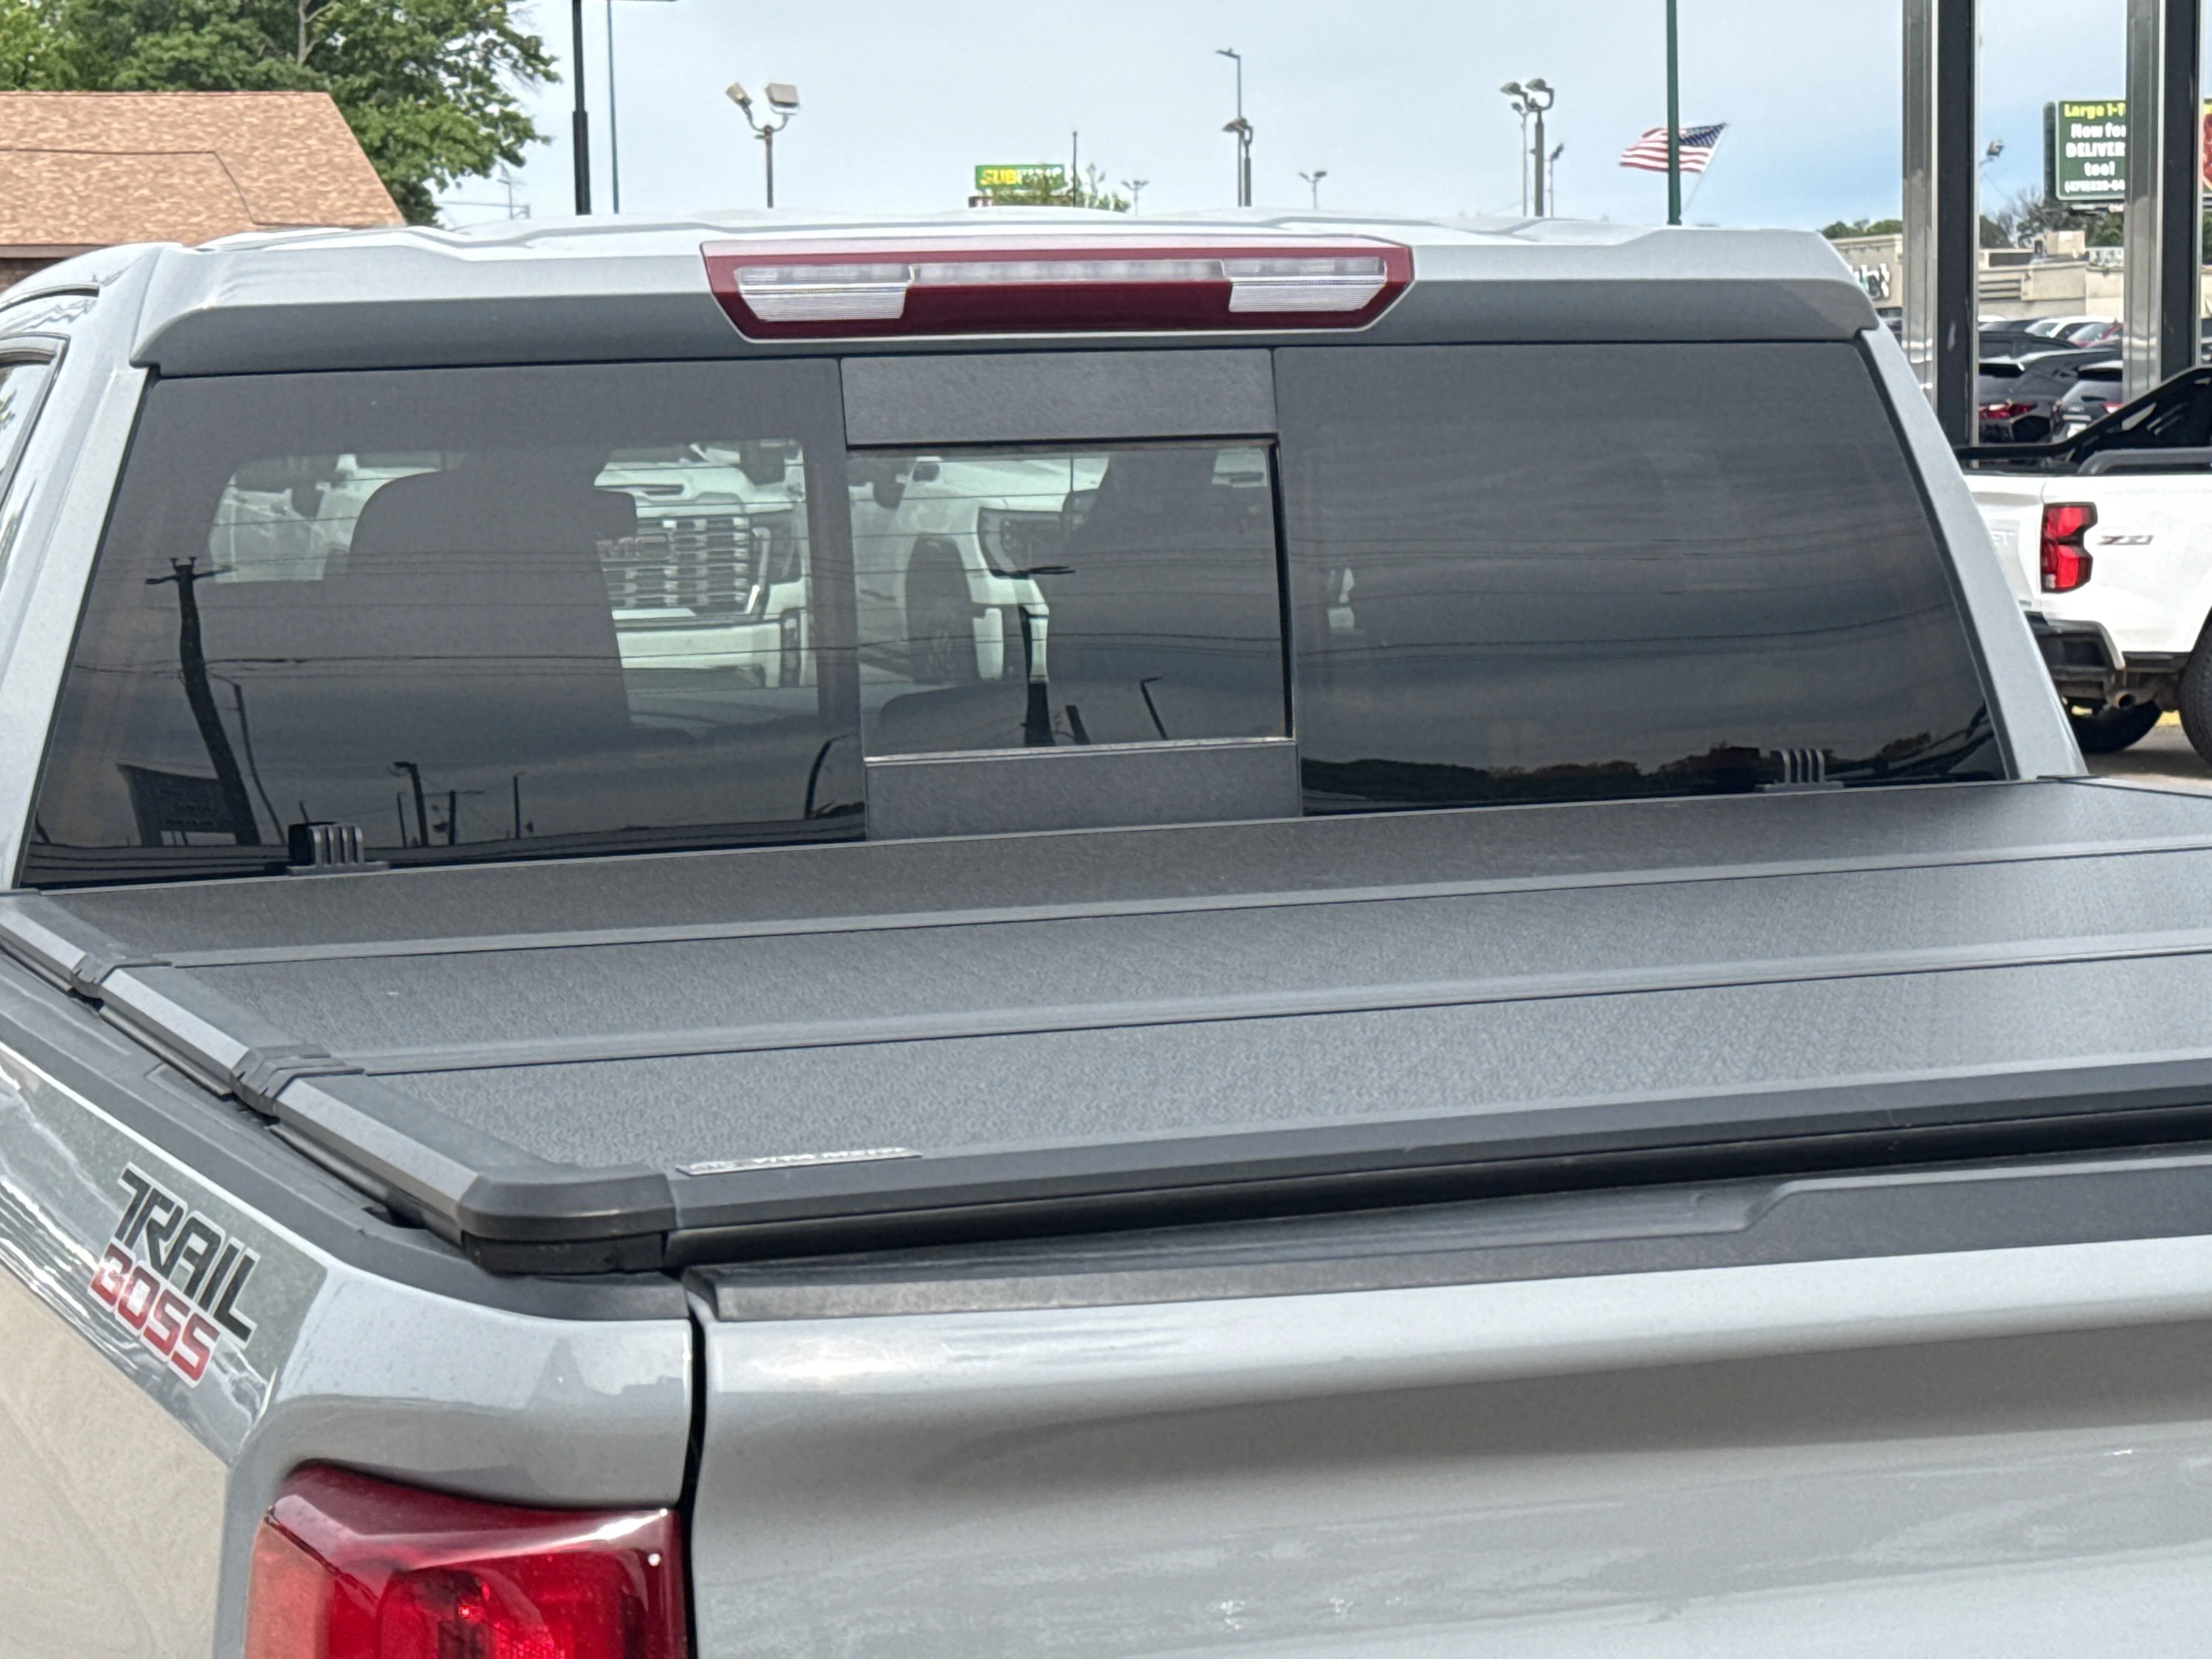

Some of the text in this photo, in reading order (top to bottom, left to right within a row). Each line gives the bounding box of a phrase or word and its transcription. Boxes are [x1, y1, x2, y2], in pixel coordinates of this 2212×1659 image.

[2106, 102, 2126, 117] 1-T
[2071, 123, 2103, 138] Now
[2066, 142, 2126, 158] DELIVER
[114, 1167, 257, 1344] TRAIL
[89, 1242, 222, 1382] BOSS
